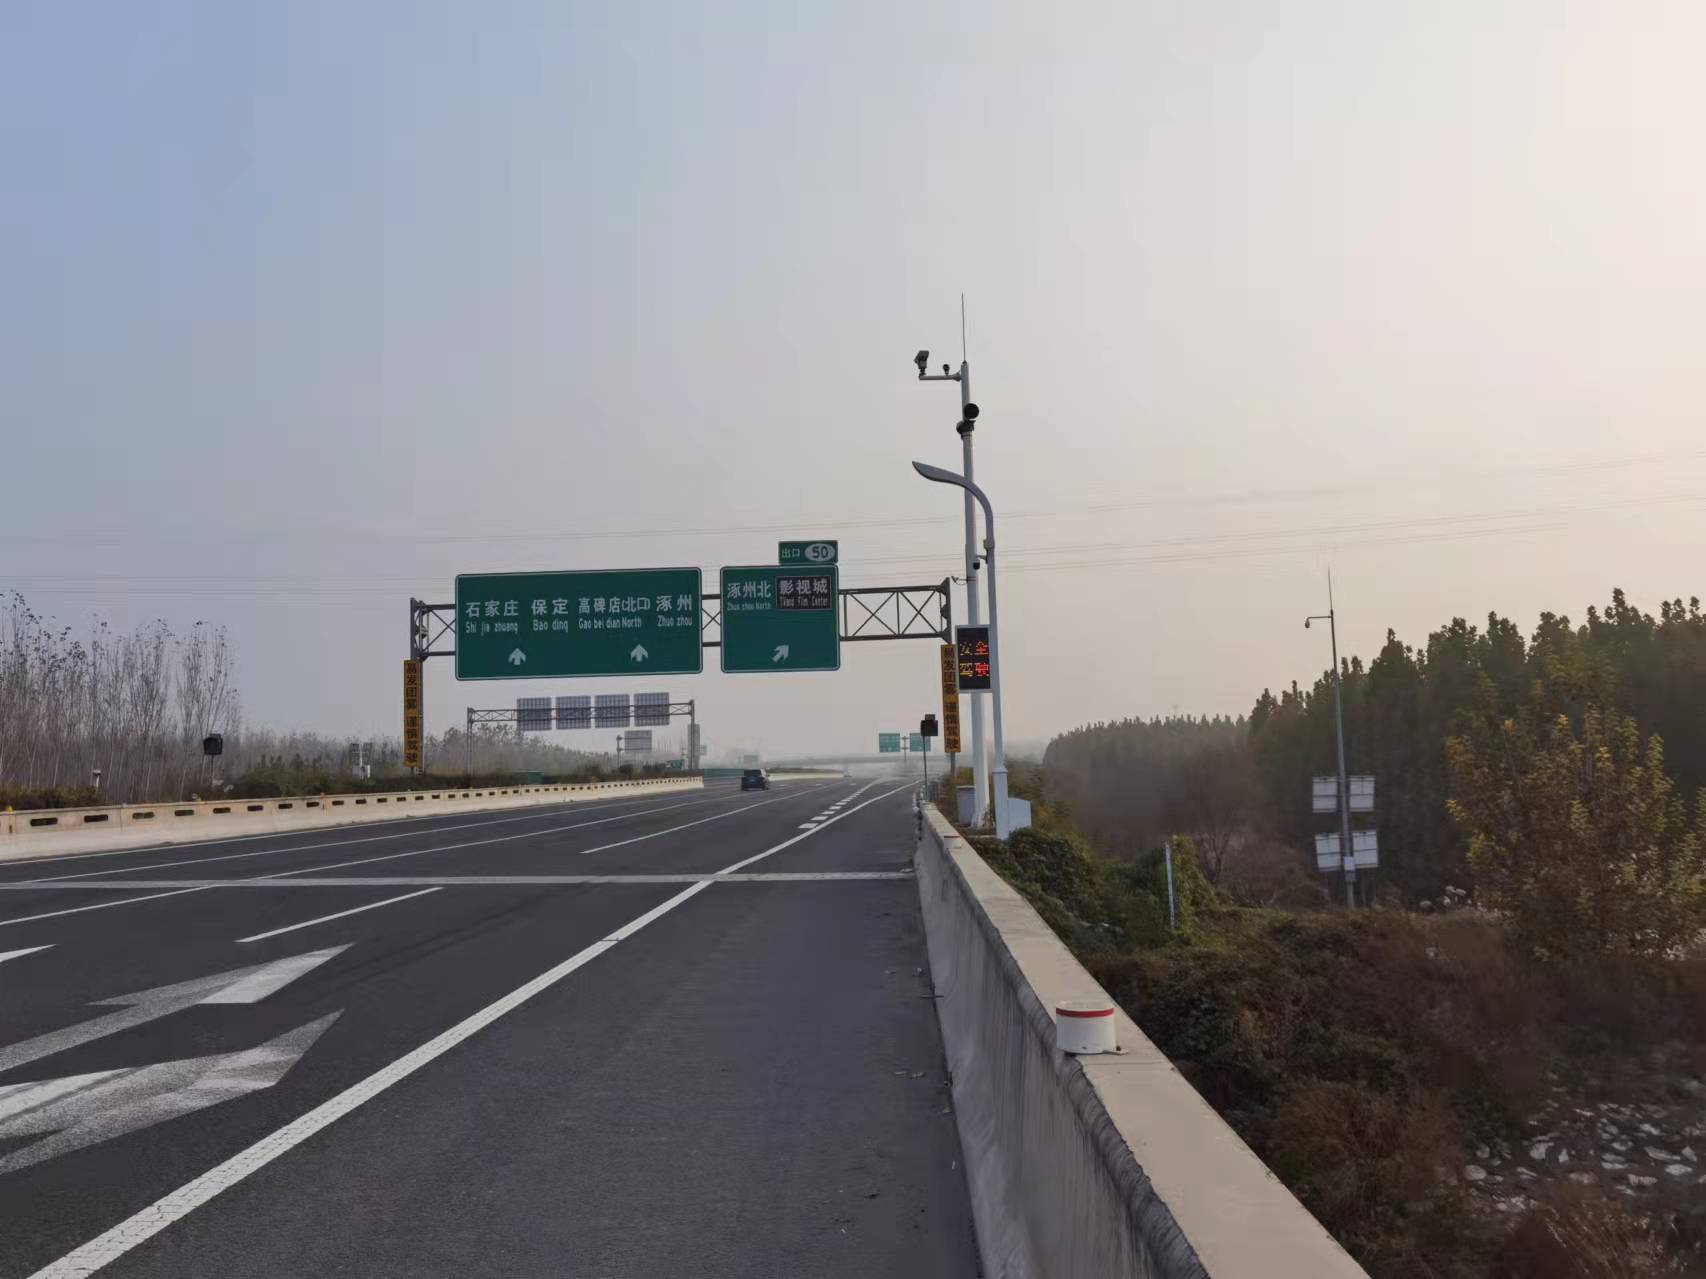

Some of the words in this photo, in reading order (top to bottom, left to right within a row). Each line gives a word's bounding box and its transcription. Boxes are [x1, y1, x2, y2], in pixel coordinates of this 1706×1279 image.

[781, 547, 801, 558] 出口
[812, 545, 829, 559] 50
[727, 580, 772, 599] 涿州北
[780, 578, 828, 595] 影视城
[465, 600, 520, 618] 石家庄
[531, 598, 569, 616] 保定
[656, 594, 692, 612] 涿州
[465, 621, 477, 634] Shi
[494, 621, 519, 635] zhuang
[533, 619, 548, 631] Bao
[552, 618, 569, 633] ding
[578, 617, 592, 630] Gao
[593, 616, 605, 629] bei
[606, 616, 621, 629] dian
[657, 614, 674, 627] Zhuo
[677, 614, 692, 626] zhou
[959, 641, 989, 656] 安全
